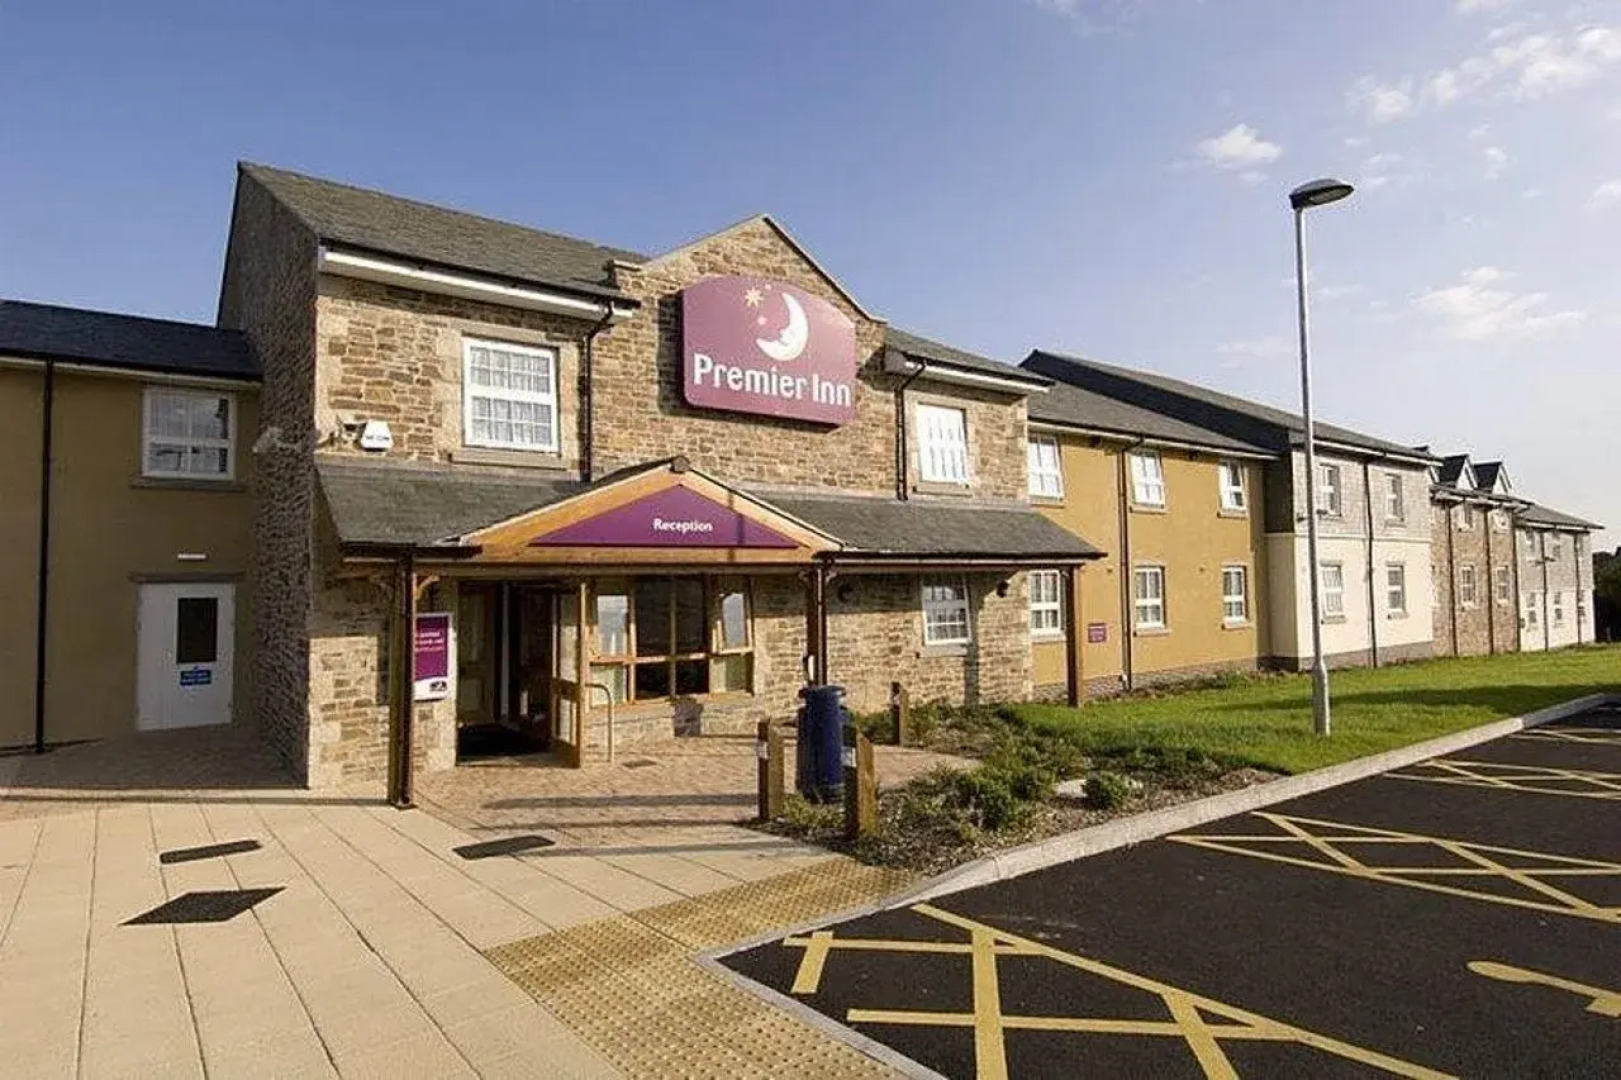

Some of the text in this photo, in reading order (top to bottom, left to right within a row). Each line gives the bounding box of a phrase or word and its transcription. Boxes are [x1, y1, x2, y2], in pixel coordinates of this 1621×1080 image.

[693, 352, 852, 407] Premier Inn
[653, 518, 713, 534] Reception
